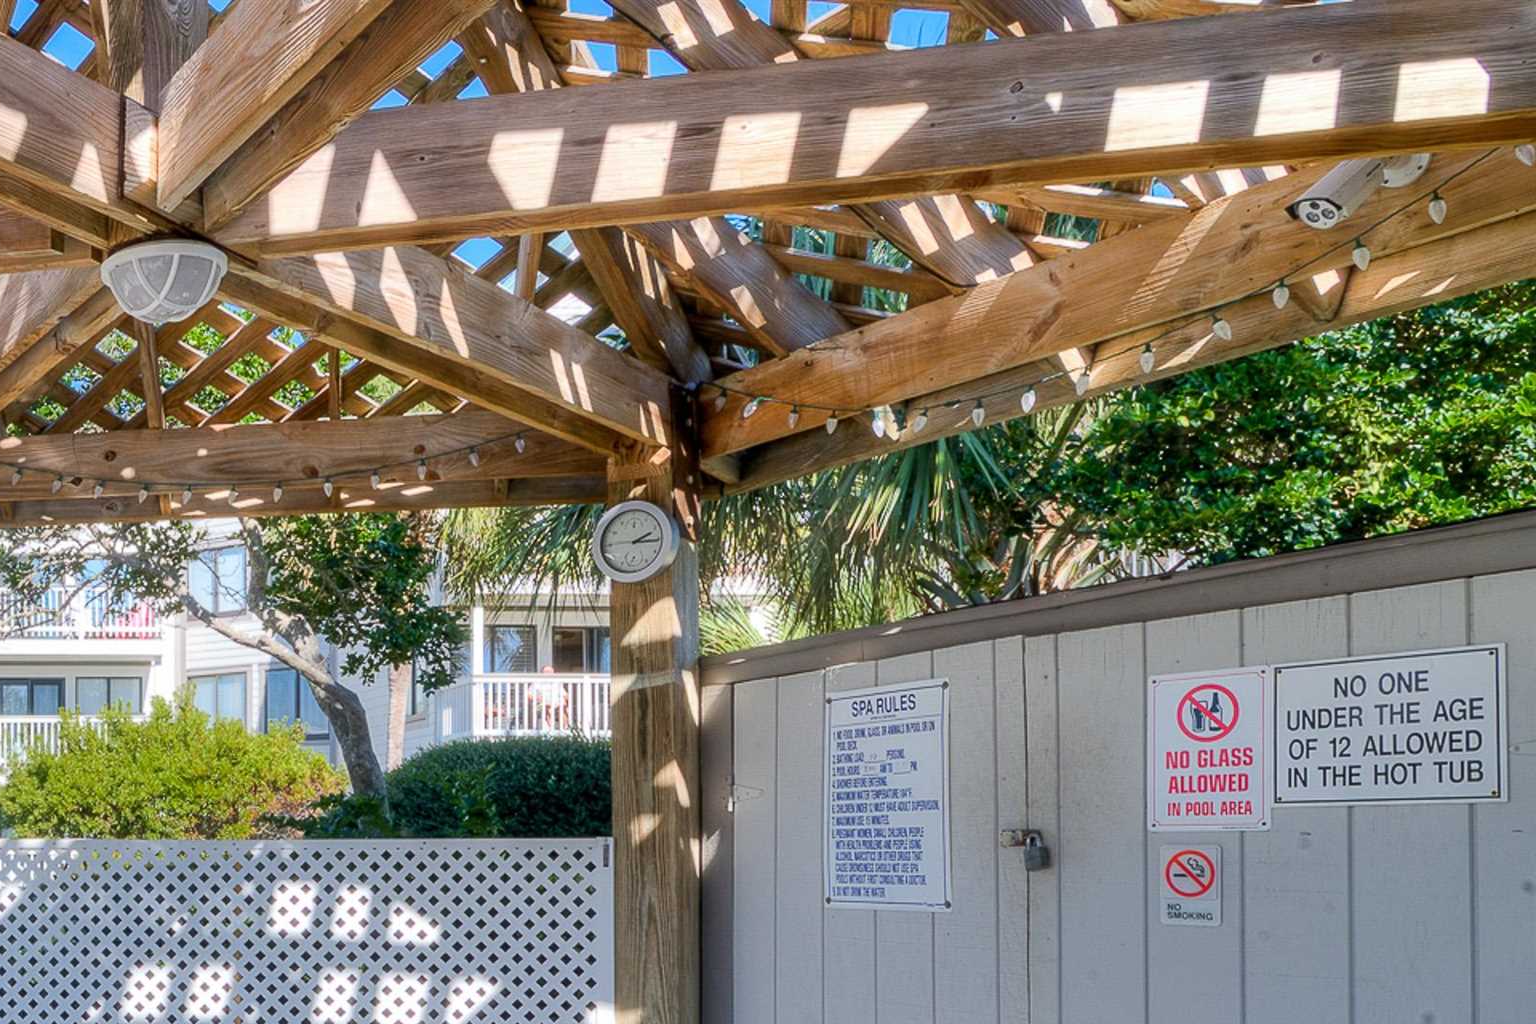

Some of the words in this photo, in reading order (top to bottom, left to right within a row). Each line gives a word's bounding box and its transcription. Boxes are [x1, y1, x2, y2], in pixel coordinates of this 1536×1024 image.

[1334, 675, 1367, 698] NO
[1378, 670, 1430, 695] ONE
[851, 699, 874, 718] SPA
[876, 693, 916, 715] RULES
[1287, 706, 1363, 731] UNDER
[1374, 702, 1421, 725] THE
[1433, 697, 1485, 722] AGE
[1289, 738, 1318, 760] OF
[1329, 736, 1351, 758] 12
[1363, 729, 1483, 757] ALLOWED
[1166, 750, 1190, 769] NO
[1197, 747, 1254, 768] GLASS
[1168, 773, 1249, 794] ALLOWED
[1287, 767, 1308, 788] IN
[1318, 765, 1362, 787] THE
[1374, 762, 1422, 785] HOT
[1433, 760, 1484, 783] TUB
[1167, 802, 1181, 817] IN
[1185, 801, 1216, 816] POOL
[1220, 800, 1253, 816] AREA
[1167, 903, 1182, 911] NO
[1167, 911, 1214, 921] SMOKING
